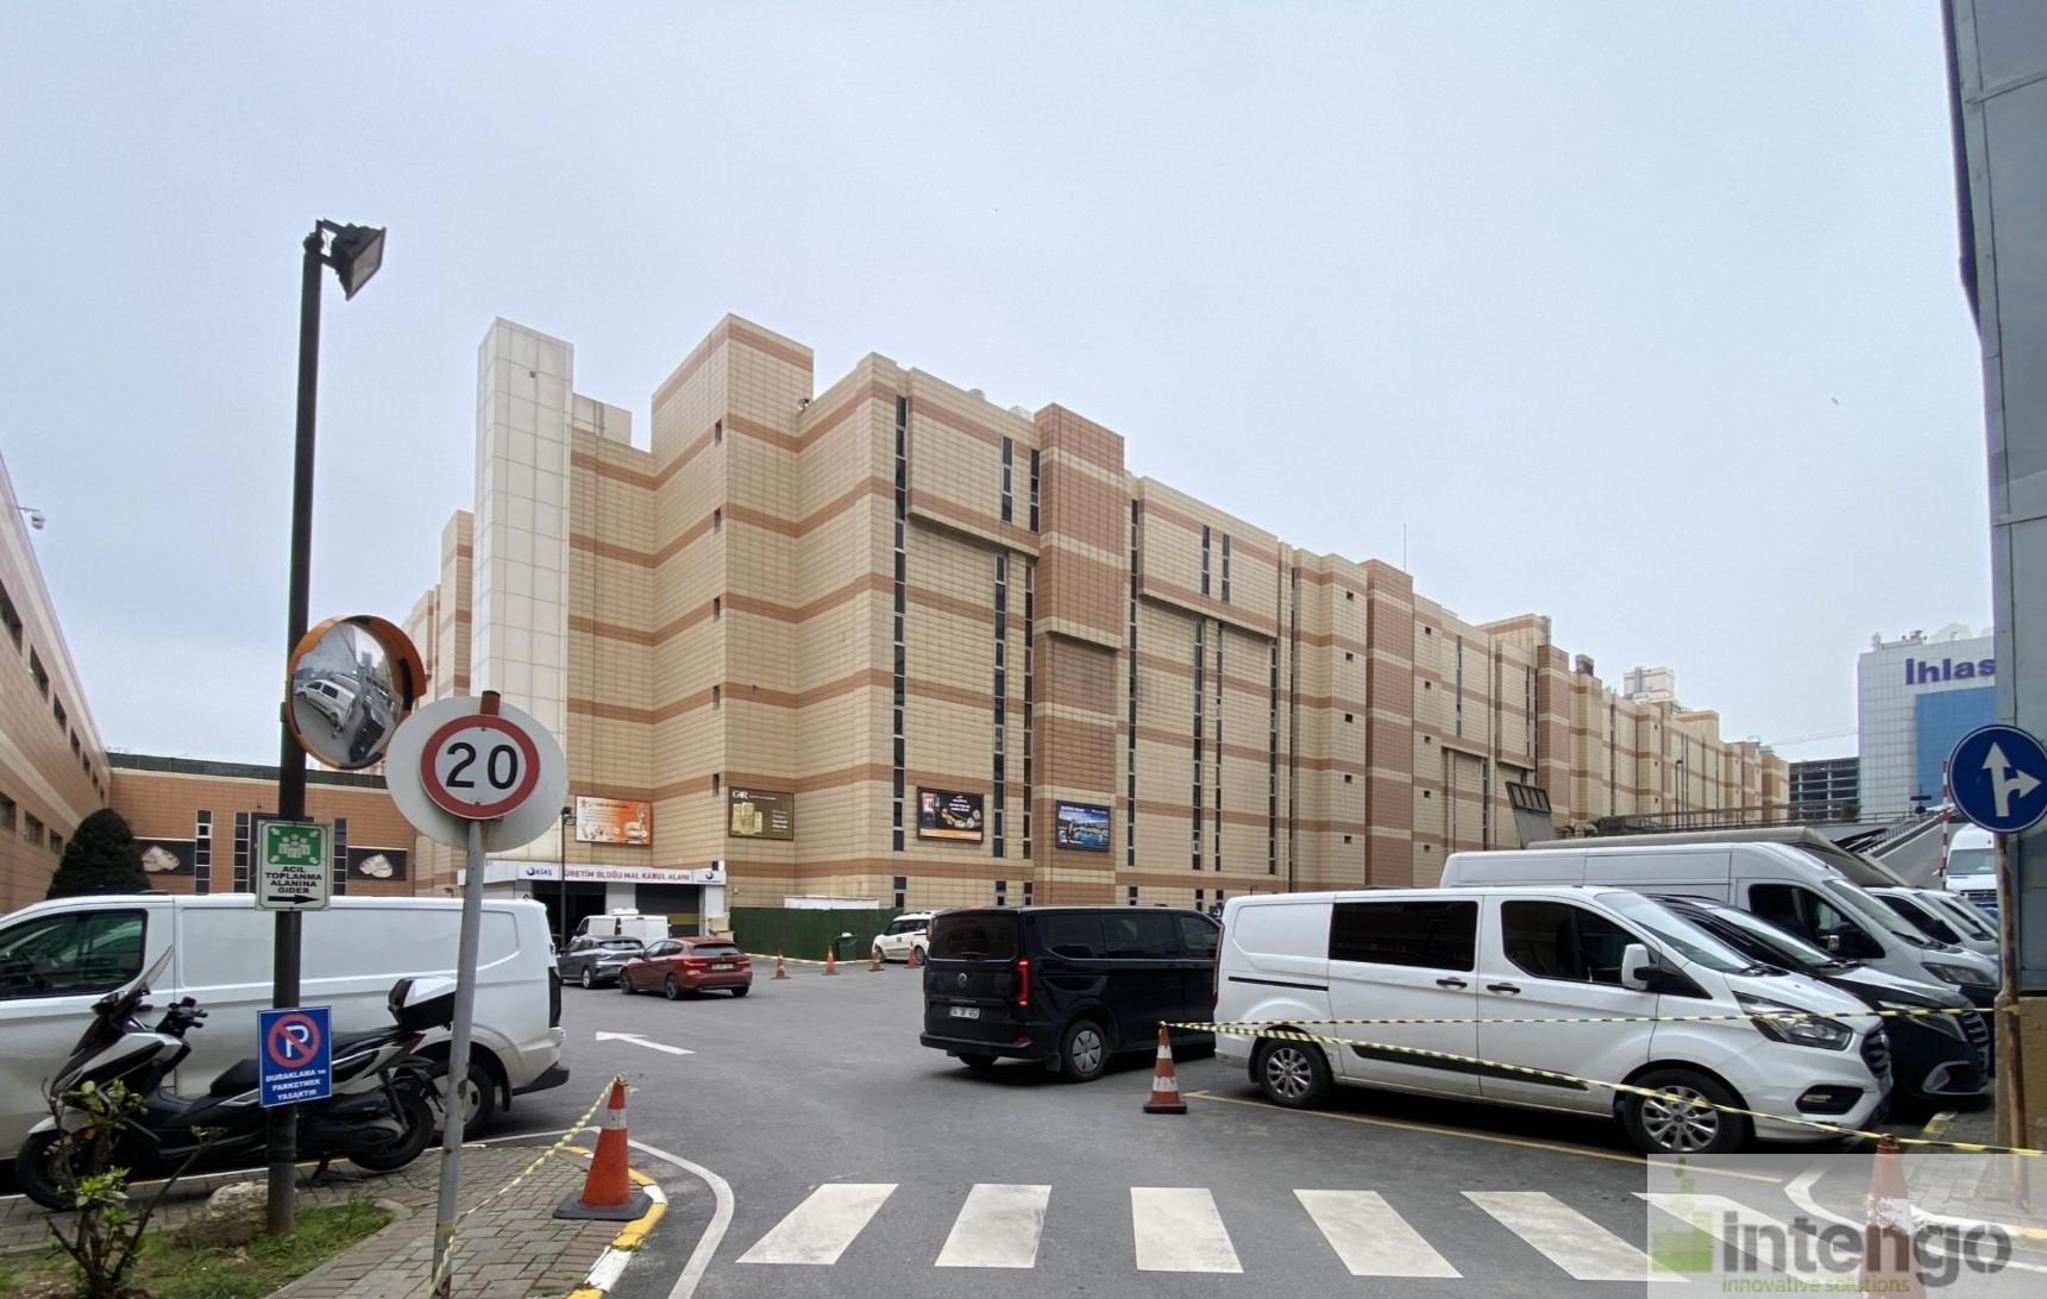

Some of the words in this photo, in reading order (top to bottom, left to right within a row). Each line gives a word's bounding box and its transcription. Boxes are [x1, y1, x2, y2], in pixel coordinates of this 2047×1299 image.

[445, 742, 519, 790] 20
[265, 872, 322, 880] TOPLANMA
[266, 1070, 315, 1082] DURAKLAMA
